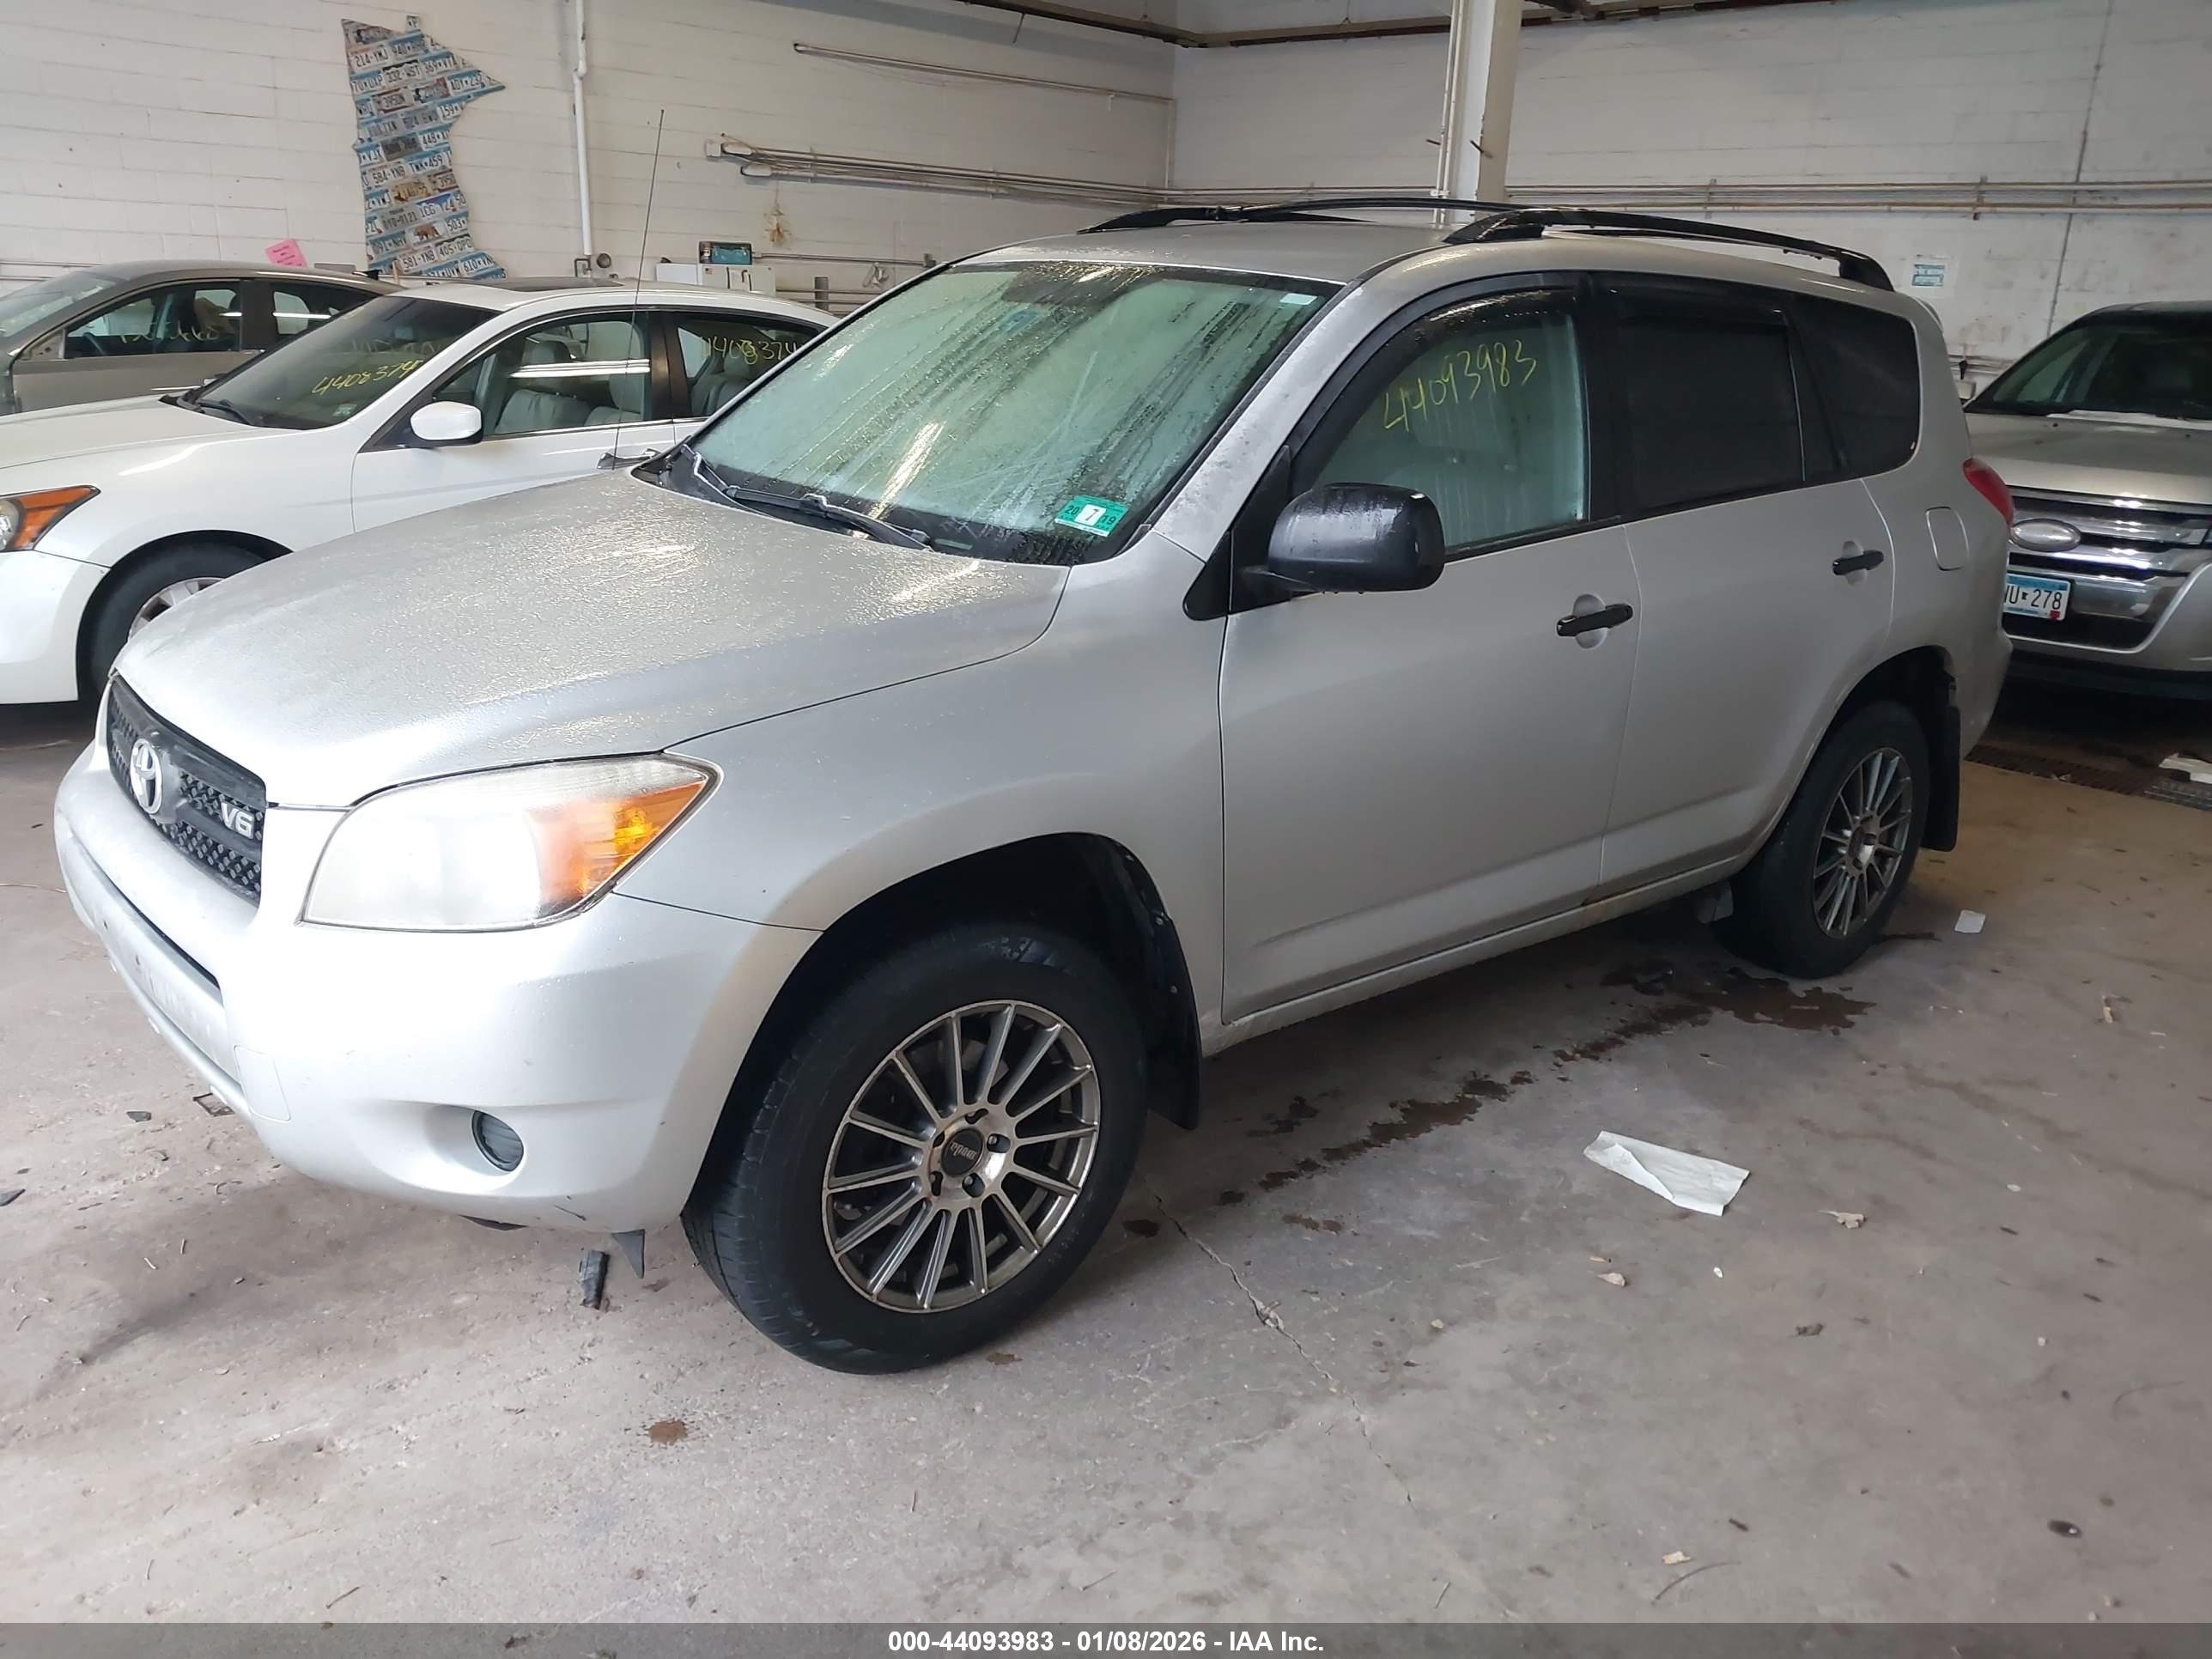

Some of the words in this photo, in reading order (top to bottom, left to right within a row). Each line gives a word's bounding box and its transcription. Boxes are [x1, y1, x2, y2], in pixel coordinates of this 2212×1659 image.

[1384, 339, 1537, 433] 44093983
[2031, 588, 2063, 610] 278
[220, 801, 254, 840] V6
